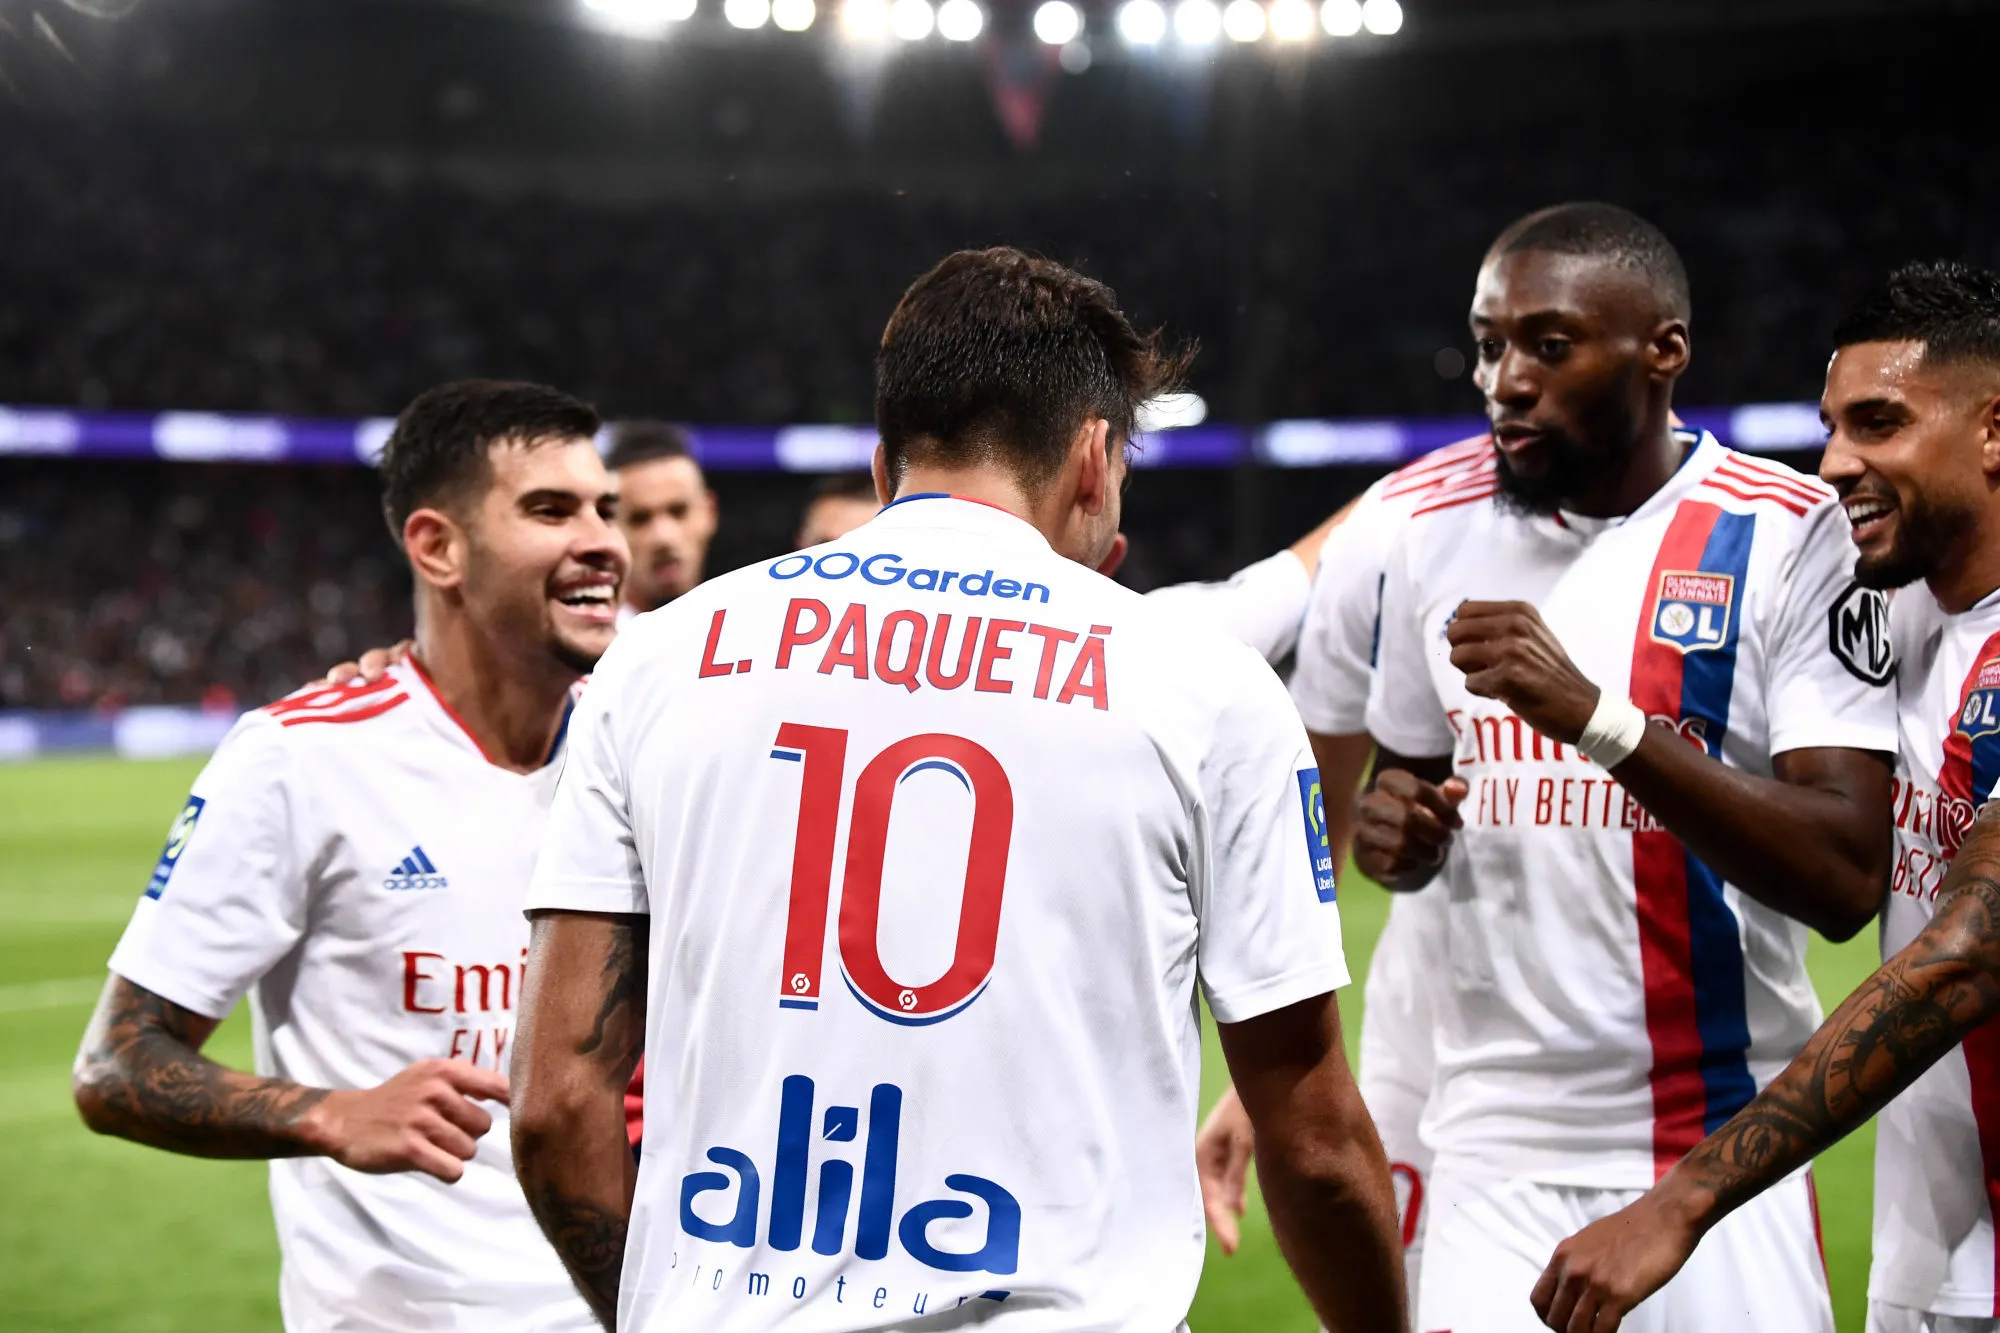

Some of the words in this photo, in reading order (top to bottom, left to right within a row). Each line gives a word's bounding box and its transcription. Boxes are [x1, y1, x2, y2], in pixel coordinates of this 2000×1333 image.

[768, 552, 1050, 604] OOGarden
[698, 609, 753, 680] L.
[1841, 591, 1892, 675] MG
[1477, 776, 1520, 826] FLY
[383, 873, 448, 891] adidas
[769, 721, 1015, 1028] 10
[679, 1073, 1022, 1276] alila
